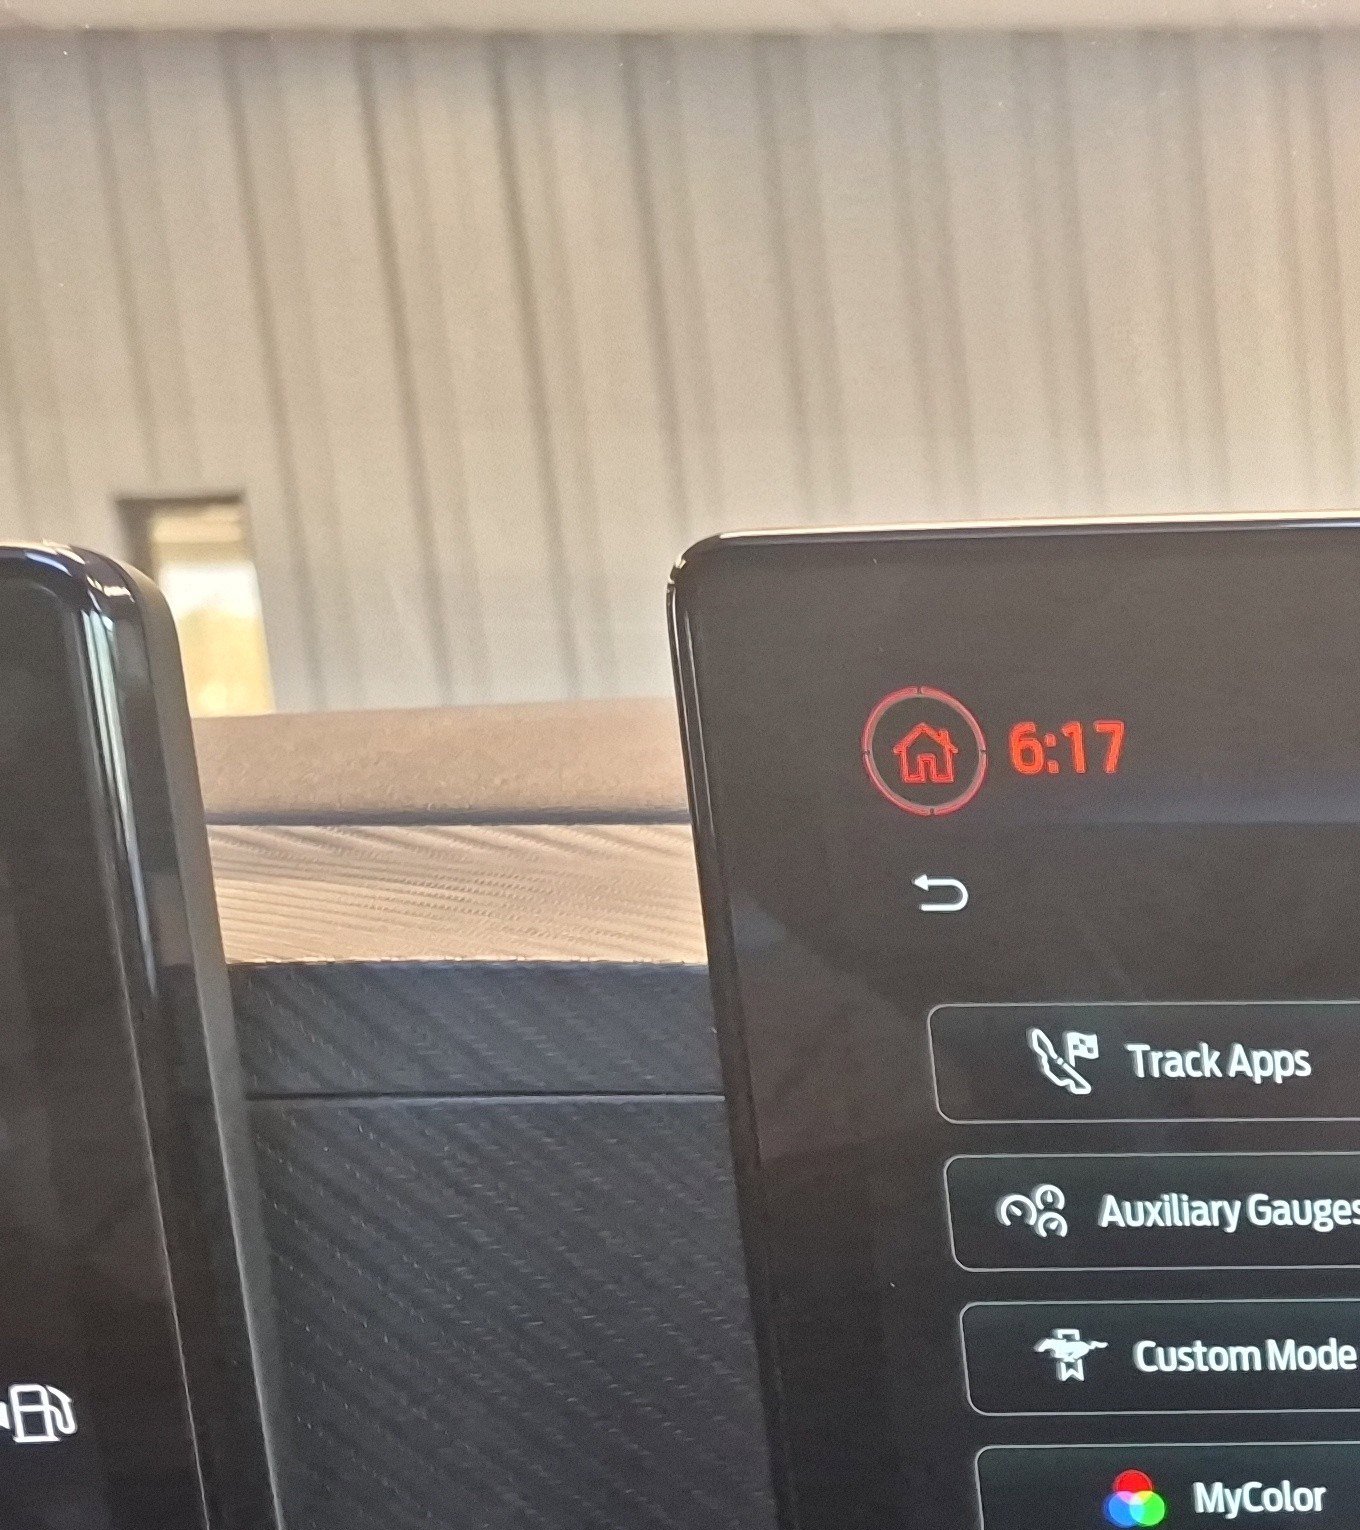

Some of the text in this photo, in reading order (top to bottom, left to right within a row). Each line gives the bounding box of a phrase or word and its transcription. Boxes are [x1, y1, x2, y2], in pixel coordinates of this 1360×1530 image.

[1009, 720, 1126, 775] 6:17
[1125, 1042, 1312, 1085] Track Apps
[1098, 1192, 1240, 1232] Auxiliary
[1133, 1337, 1358, 1373] Custom Mode
[1192, 1479, 1328, 1520] MyColor
